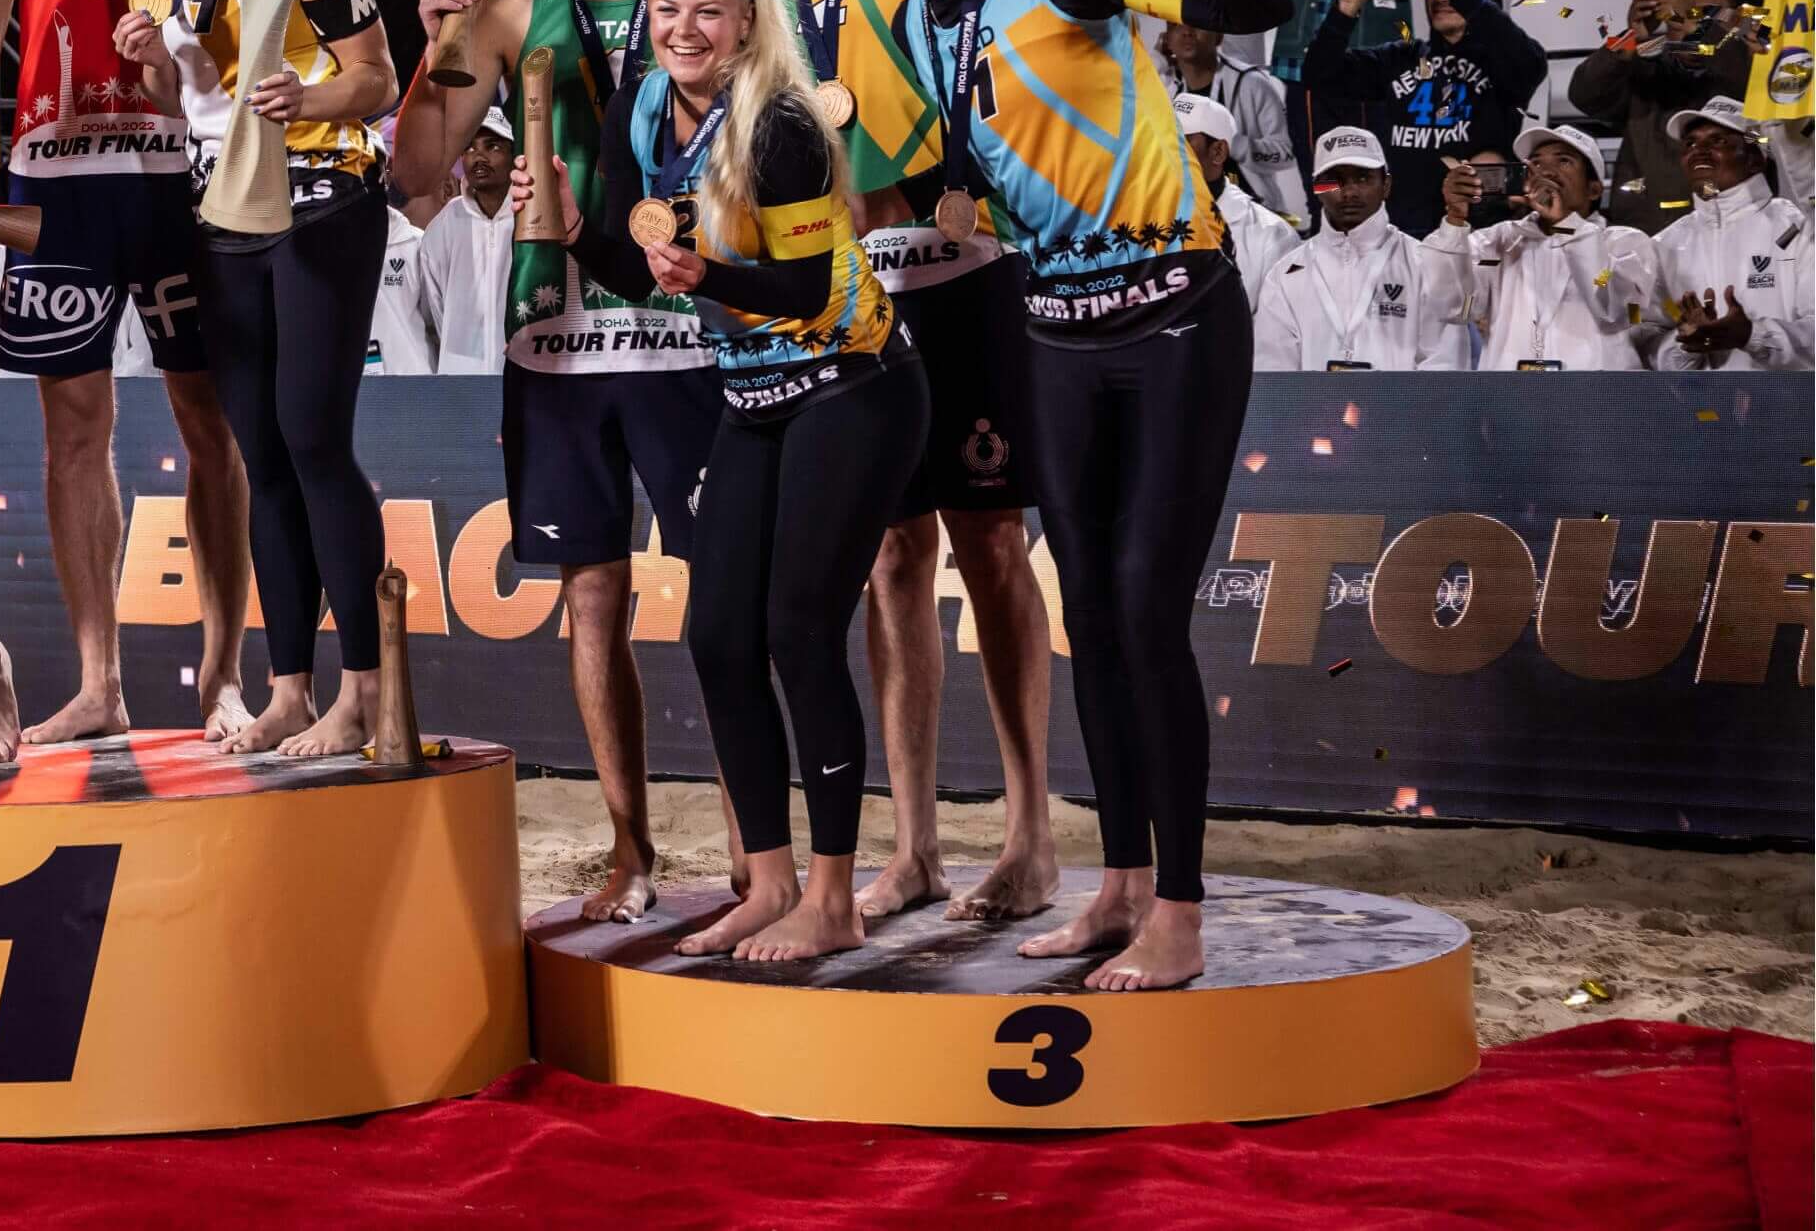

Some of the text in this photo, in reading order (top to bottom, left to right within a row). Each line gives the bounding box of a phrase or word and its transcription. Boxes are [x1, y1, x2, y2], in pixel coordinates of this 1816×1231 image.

[81, 121, 156, 133] DOHA 2022
[1391, 125, 1432, 149] NEW
[27, 134, 187, 161] TOUR FINAL
[791, 217, 832, 236] DHL
[872, 235, 909, 249] 2022
[1073, 266, 1190, 321] FINALS
[1086, 274, 1127, 293] 2022
[593, 316, 667, 330] DOHA 2022
[533, 332, 605, 355] TOUR
[988, 1005, 1092, 1107] 3
